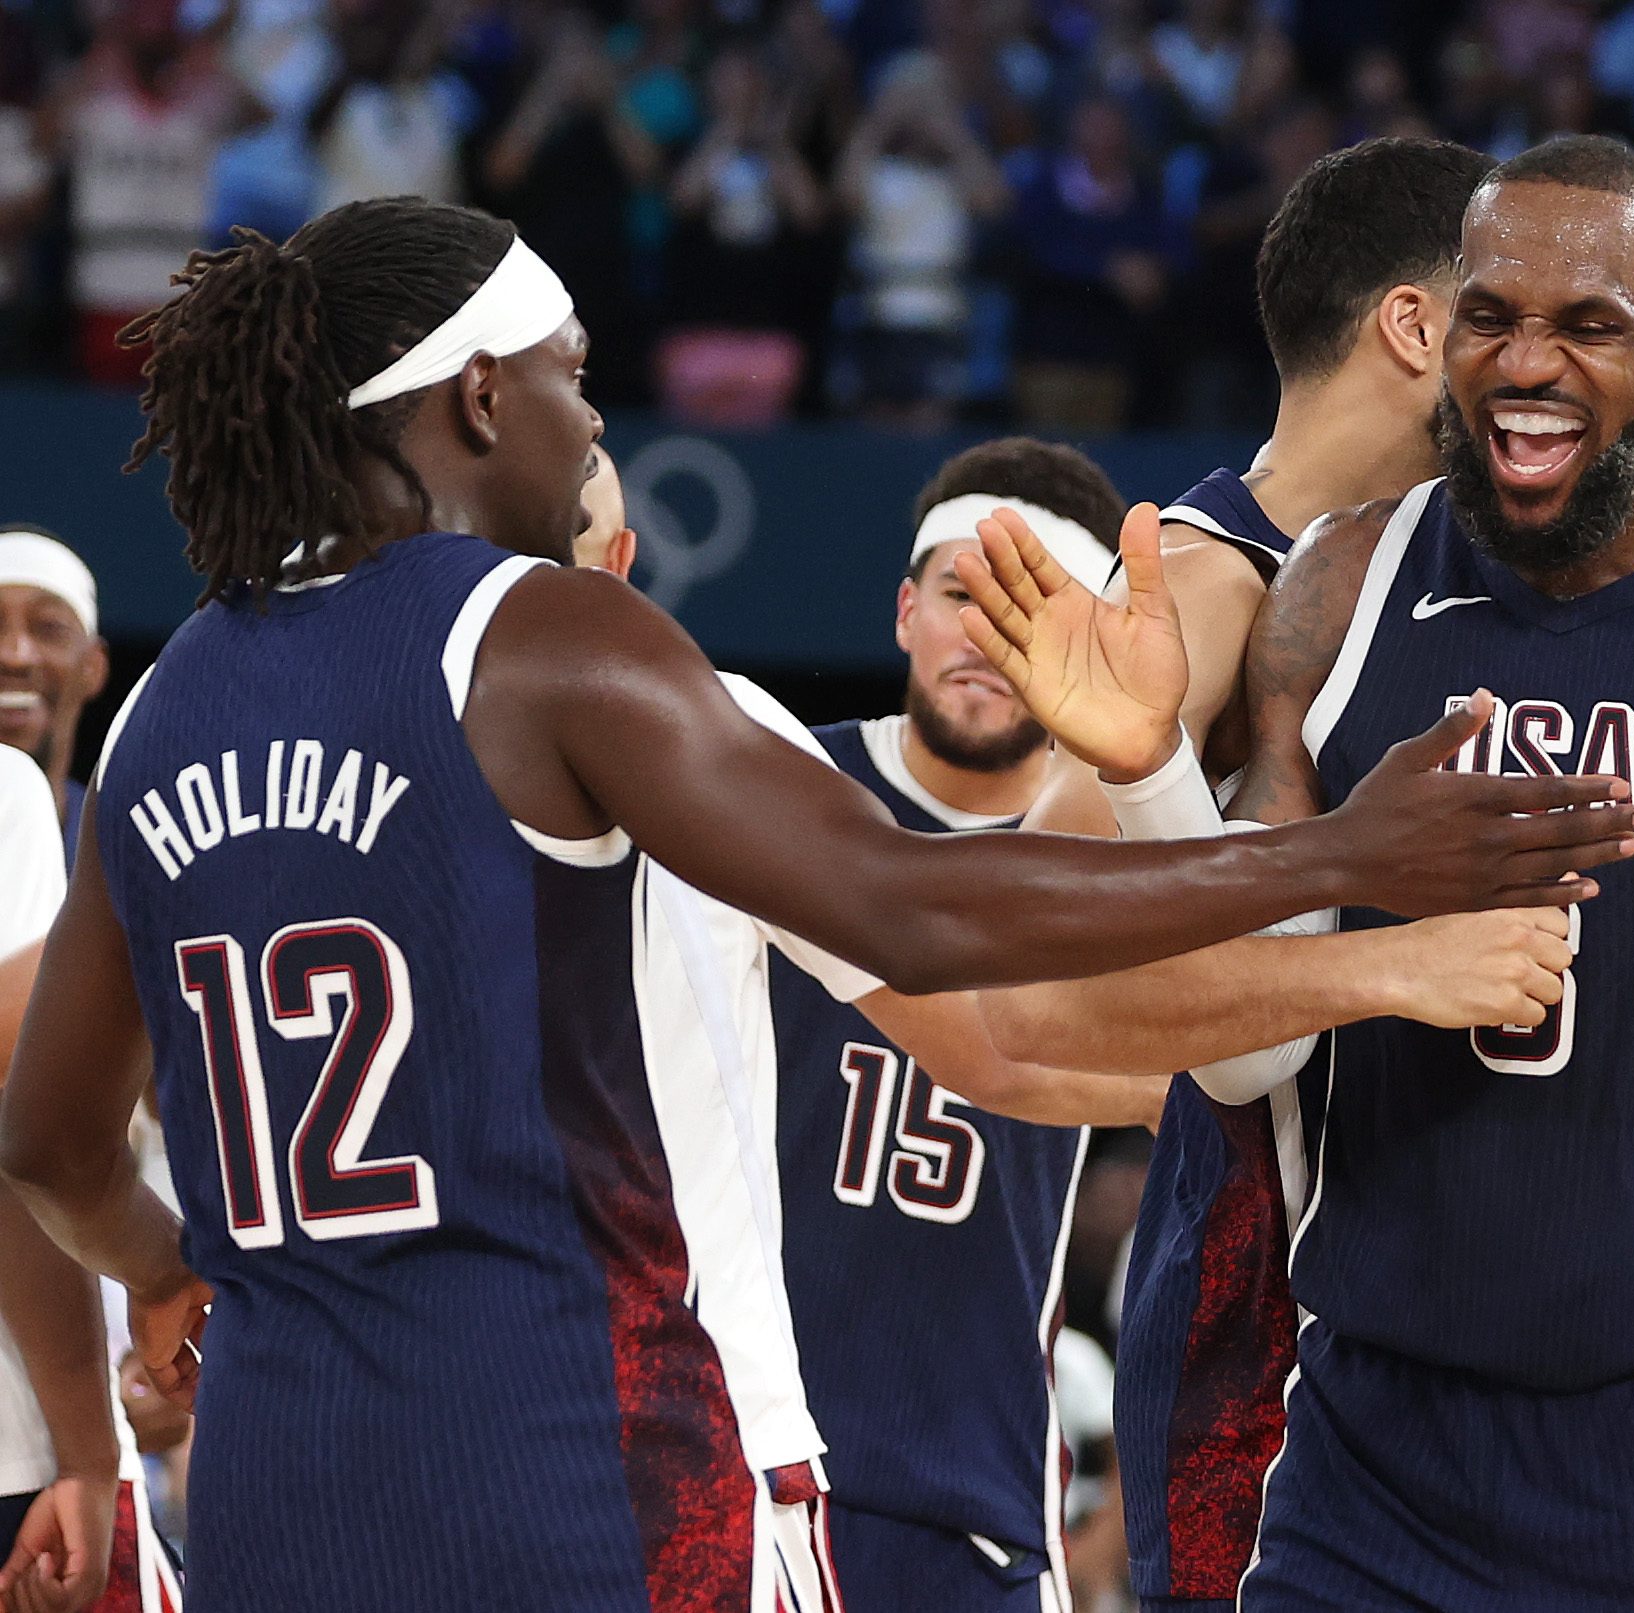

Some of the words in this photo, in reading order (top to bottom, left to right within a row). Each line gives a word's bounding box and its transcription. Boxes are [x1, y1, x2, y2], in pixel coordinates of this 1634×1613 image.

[129, 739, 410, 881] HOLIDAY
[174, 917, 439, 1251] 12
[833, 1041, 986, 1225] 15
